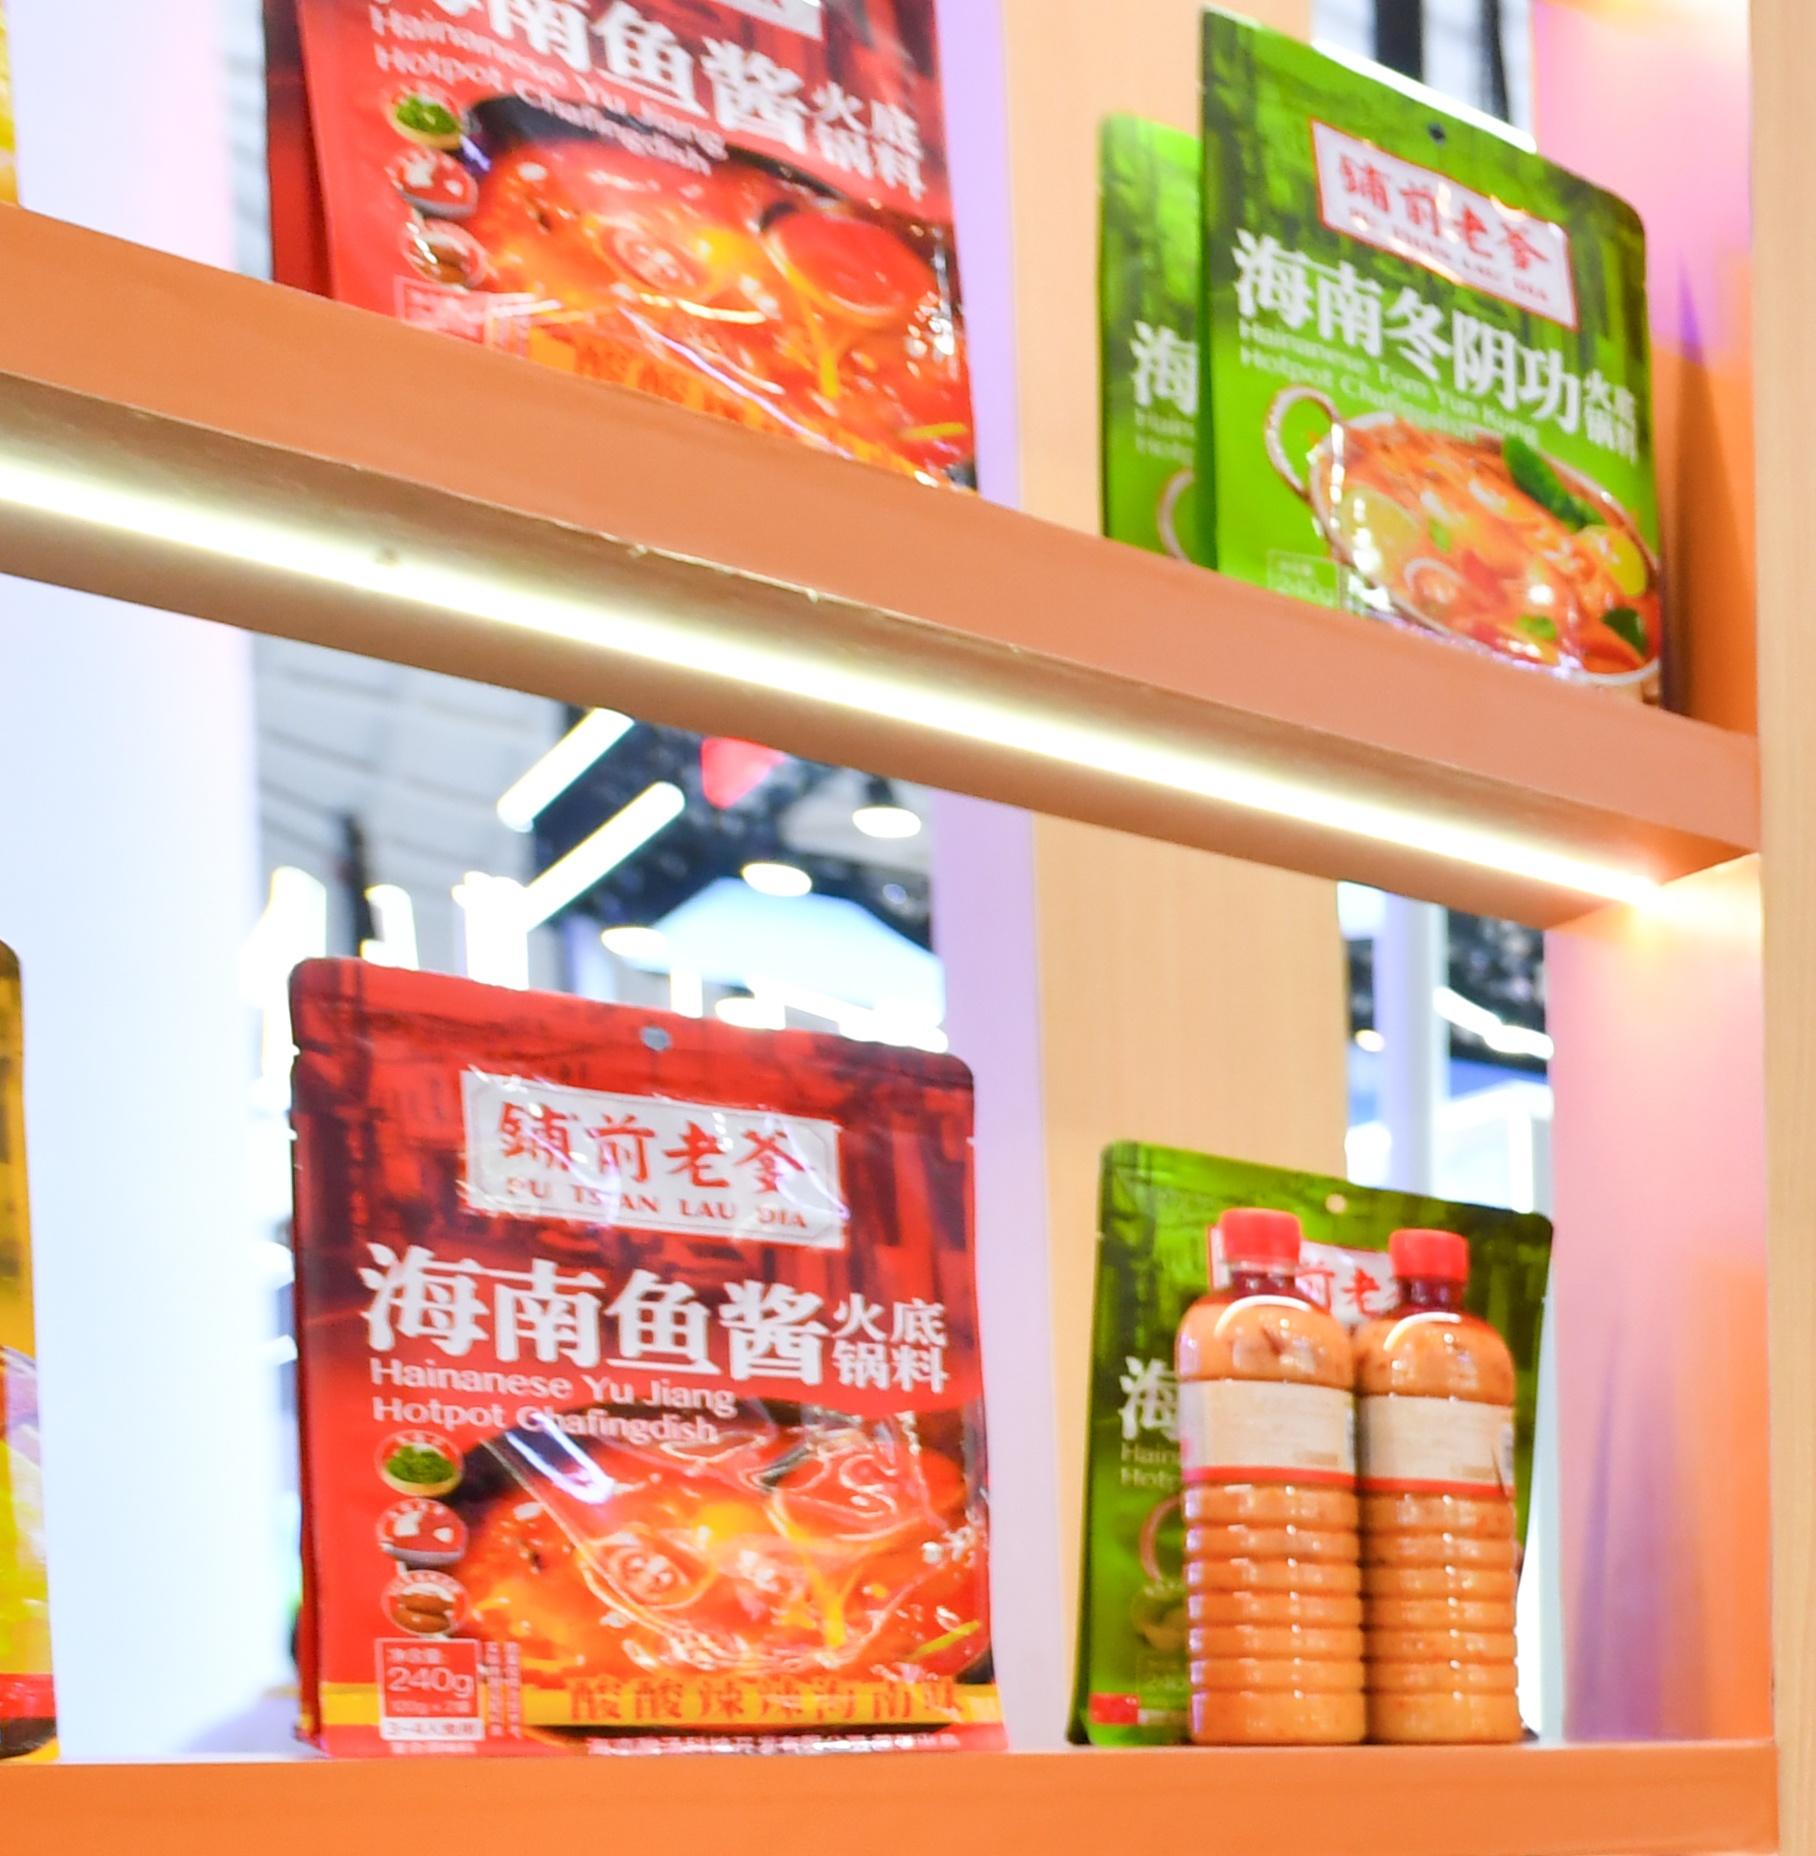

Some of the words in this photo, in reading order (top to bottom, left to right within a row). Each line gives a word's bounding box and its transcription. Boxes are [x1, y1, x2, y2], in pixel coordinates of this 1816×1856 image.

[444, 0, 808, 154] 南鱼酱
[1231, 227, 1582, 436] 海南冬阴功
[679, 1197, 737, 1223] LAU
[358, 1240, 829, 1386] 海南鱼酱
[371, 1358, 573, 1402] Hainanese
[582, 1374, 635, 1404] Yu
[642, 1375, 738, 1418] Jiang
[372, 1395, 506, 1433] Hotpot
[386, 1666, 475, 1699] 240g
